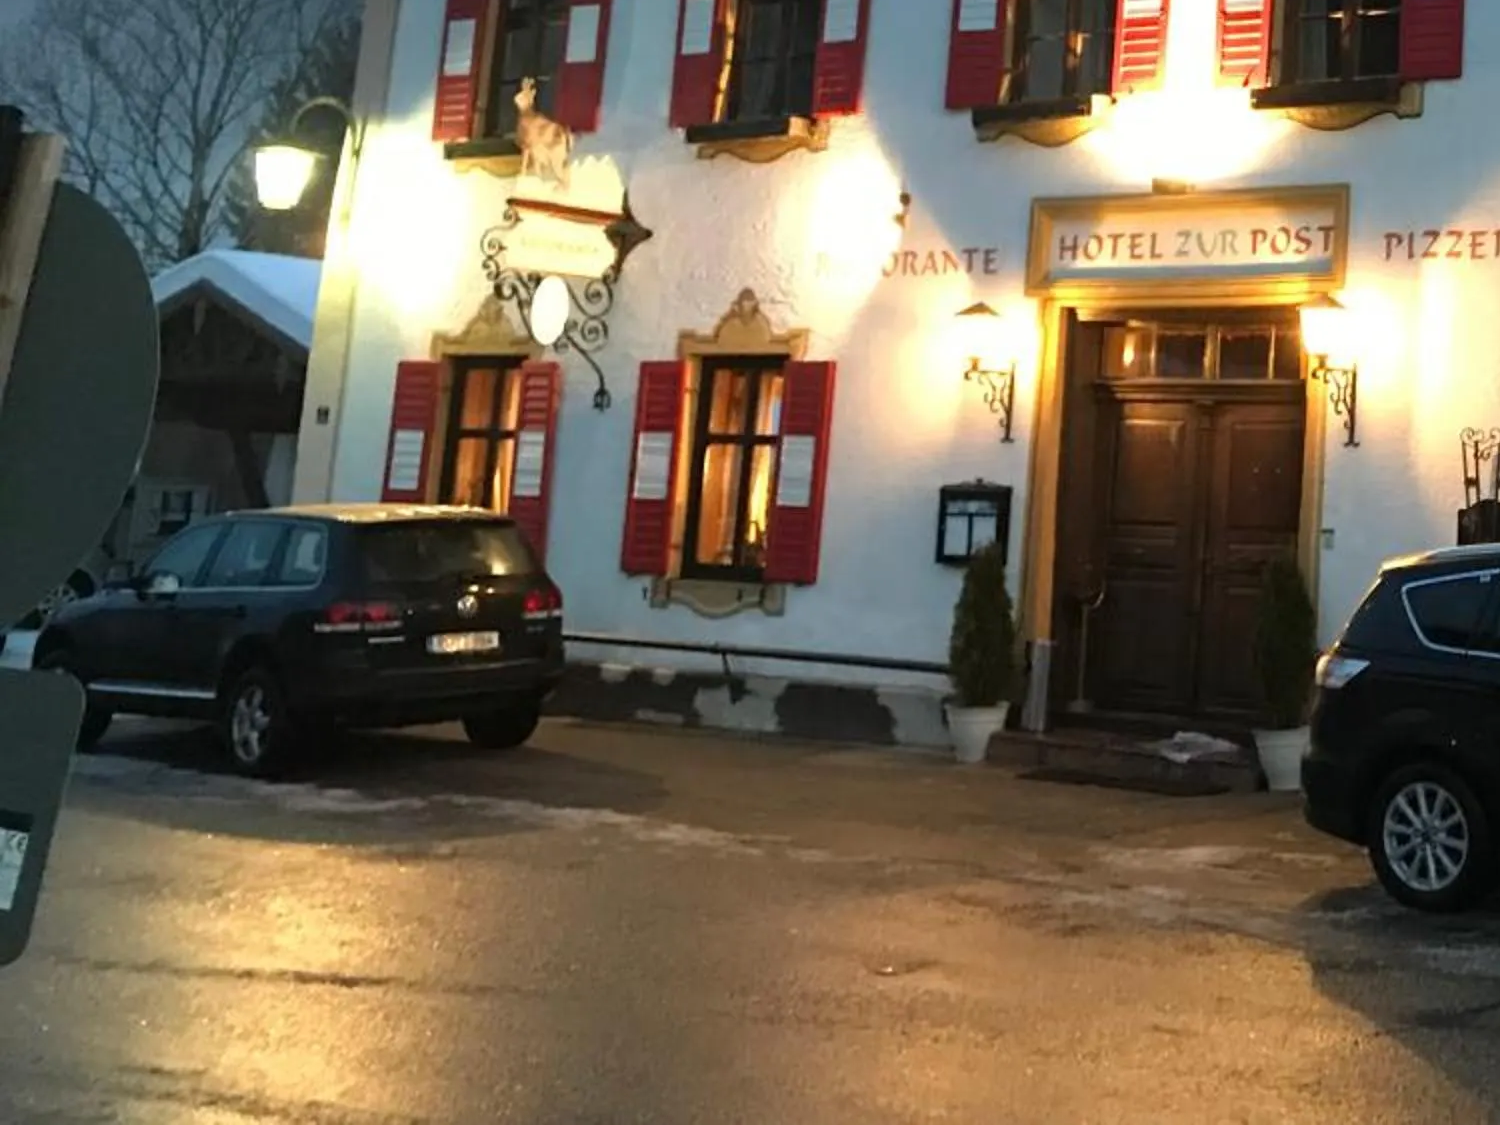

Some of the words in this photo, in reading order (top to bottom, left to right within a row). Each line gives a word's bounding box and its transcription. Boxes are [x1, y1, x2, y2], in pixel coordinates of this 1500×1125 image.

[1058, 231, 1164, 262] HOTEL
[1173, 228, 1240, 258] ZUR
[1250, 225, 1335, 256] POST
